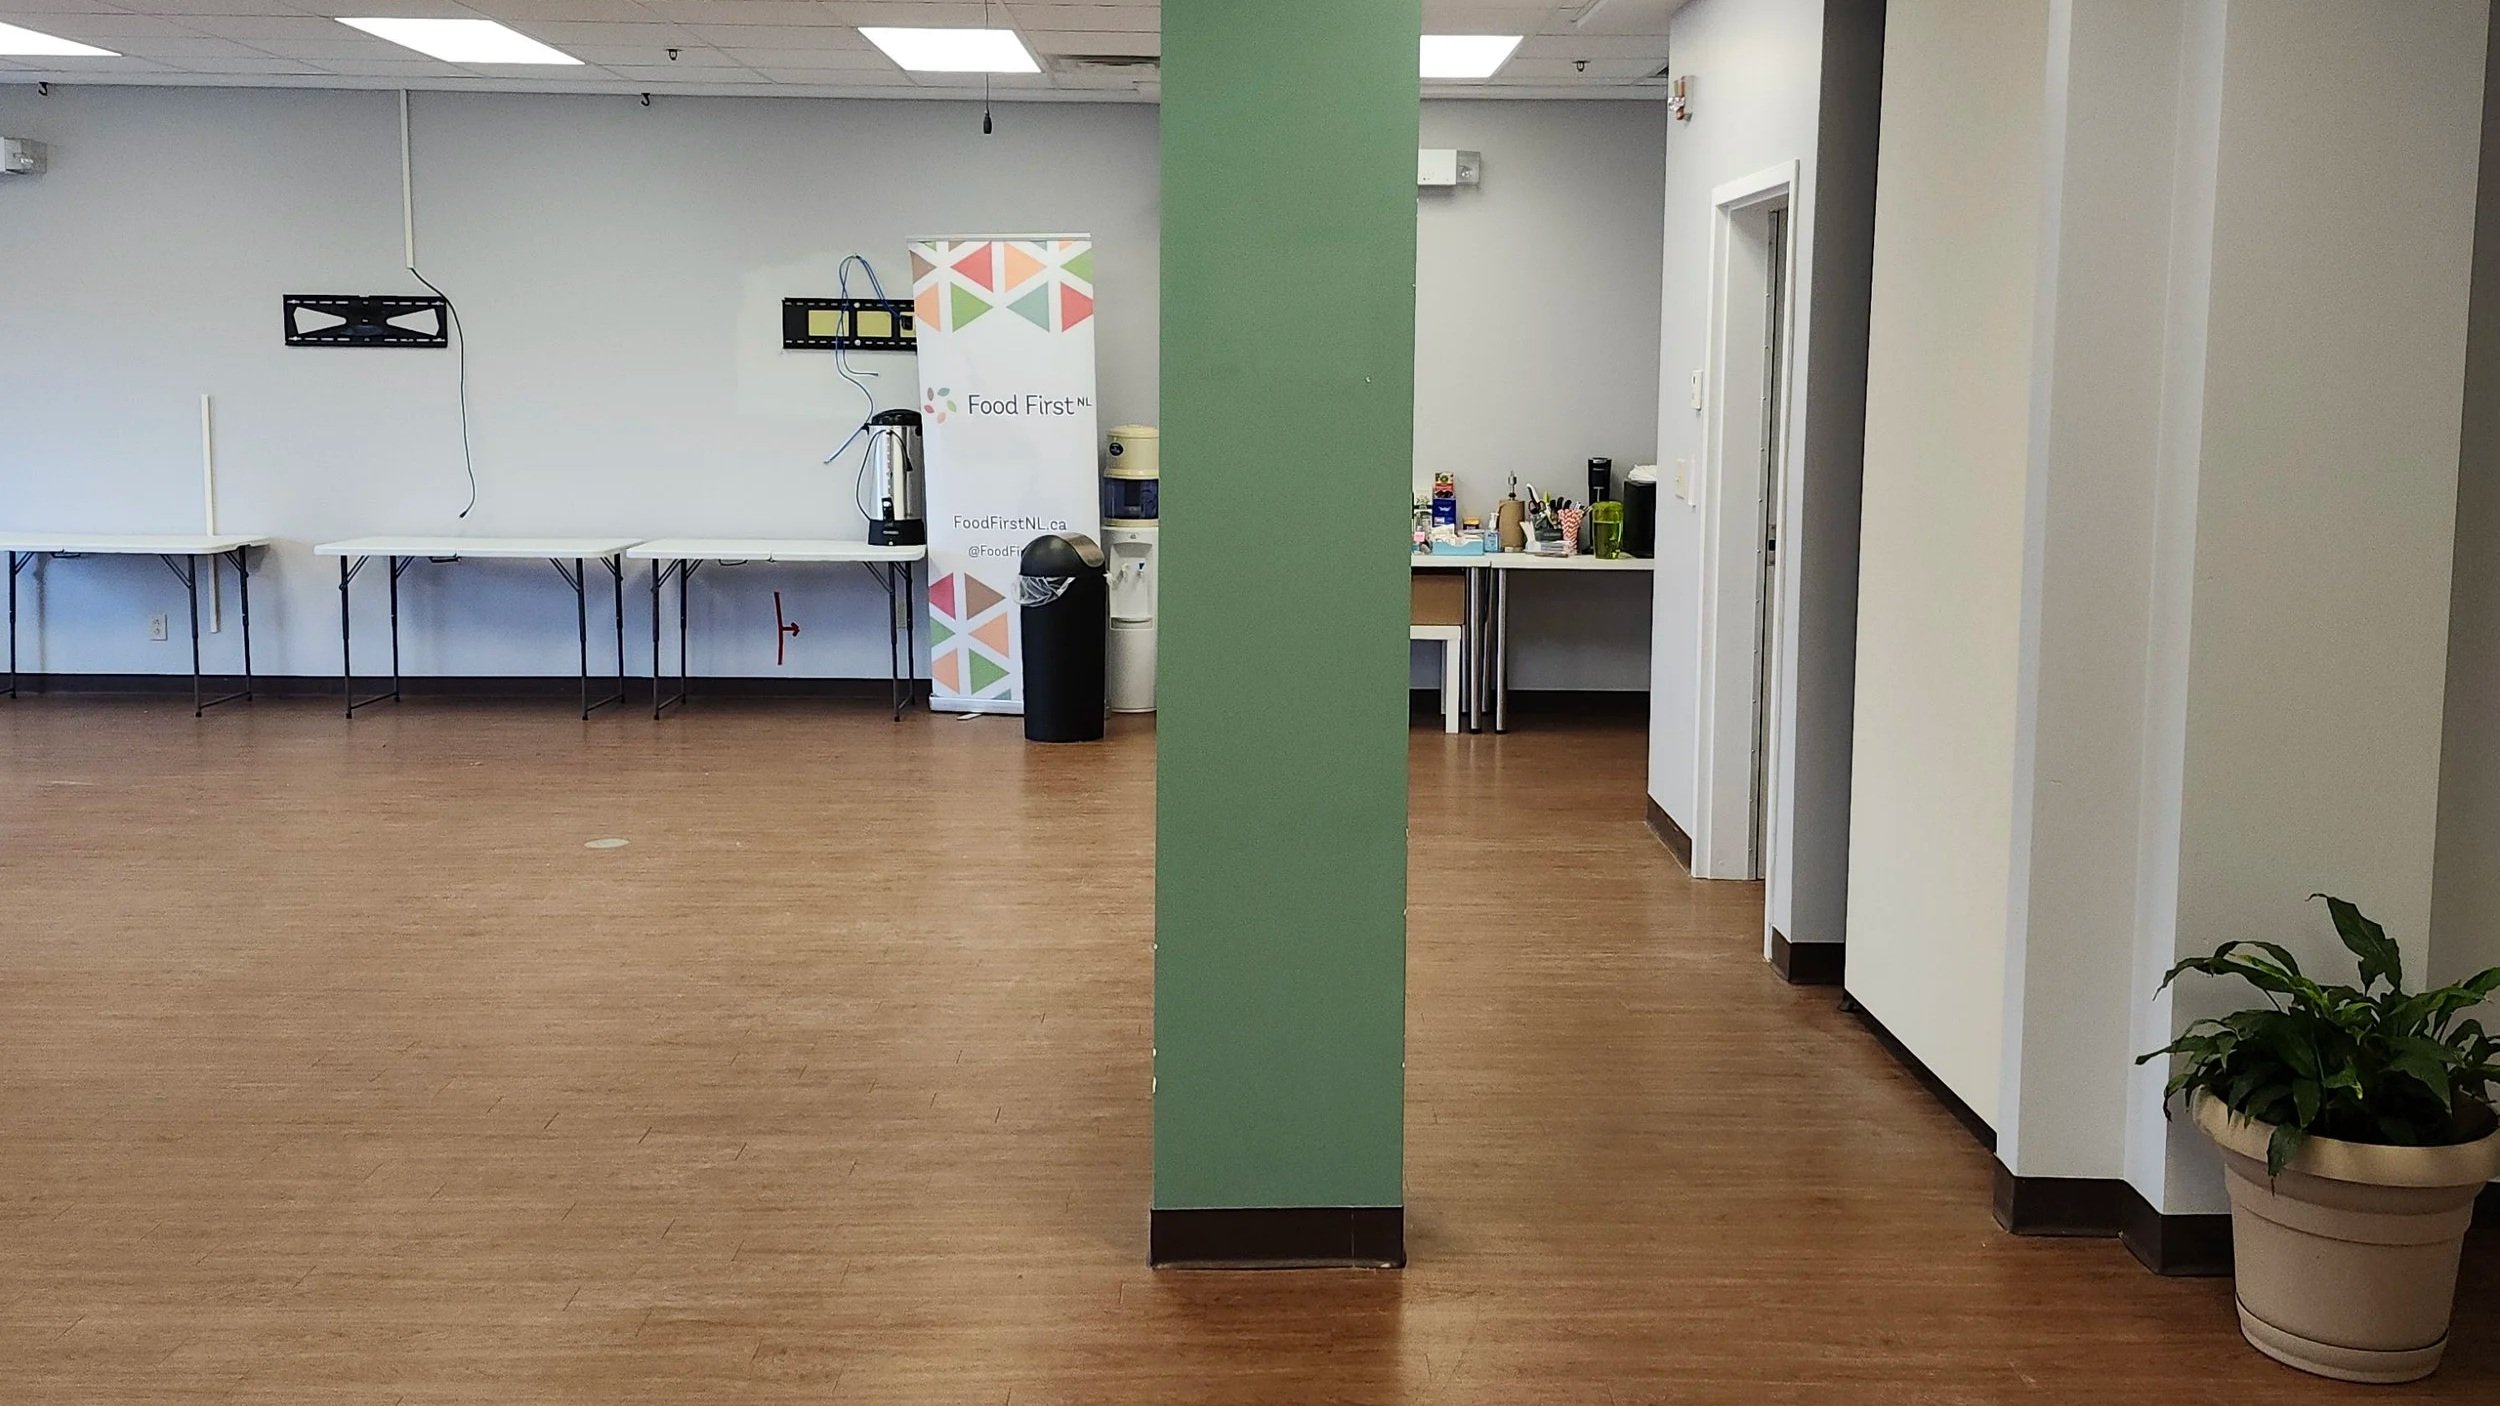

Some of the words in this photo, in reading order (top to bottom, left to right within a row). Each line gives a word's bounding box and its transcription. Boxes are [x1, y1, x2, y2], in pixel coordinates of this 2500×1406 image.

[968, 394, 1018, 415] Food
[1026, 394, 1075, 415] First
[954, 515, 1067, 531] FoodFirstNL.ca
[968, 545, 1020, 558] @FoodFi
